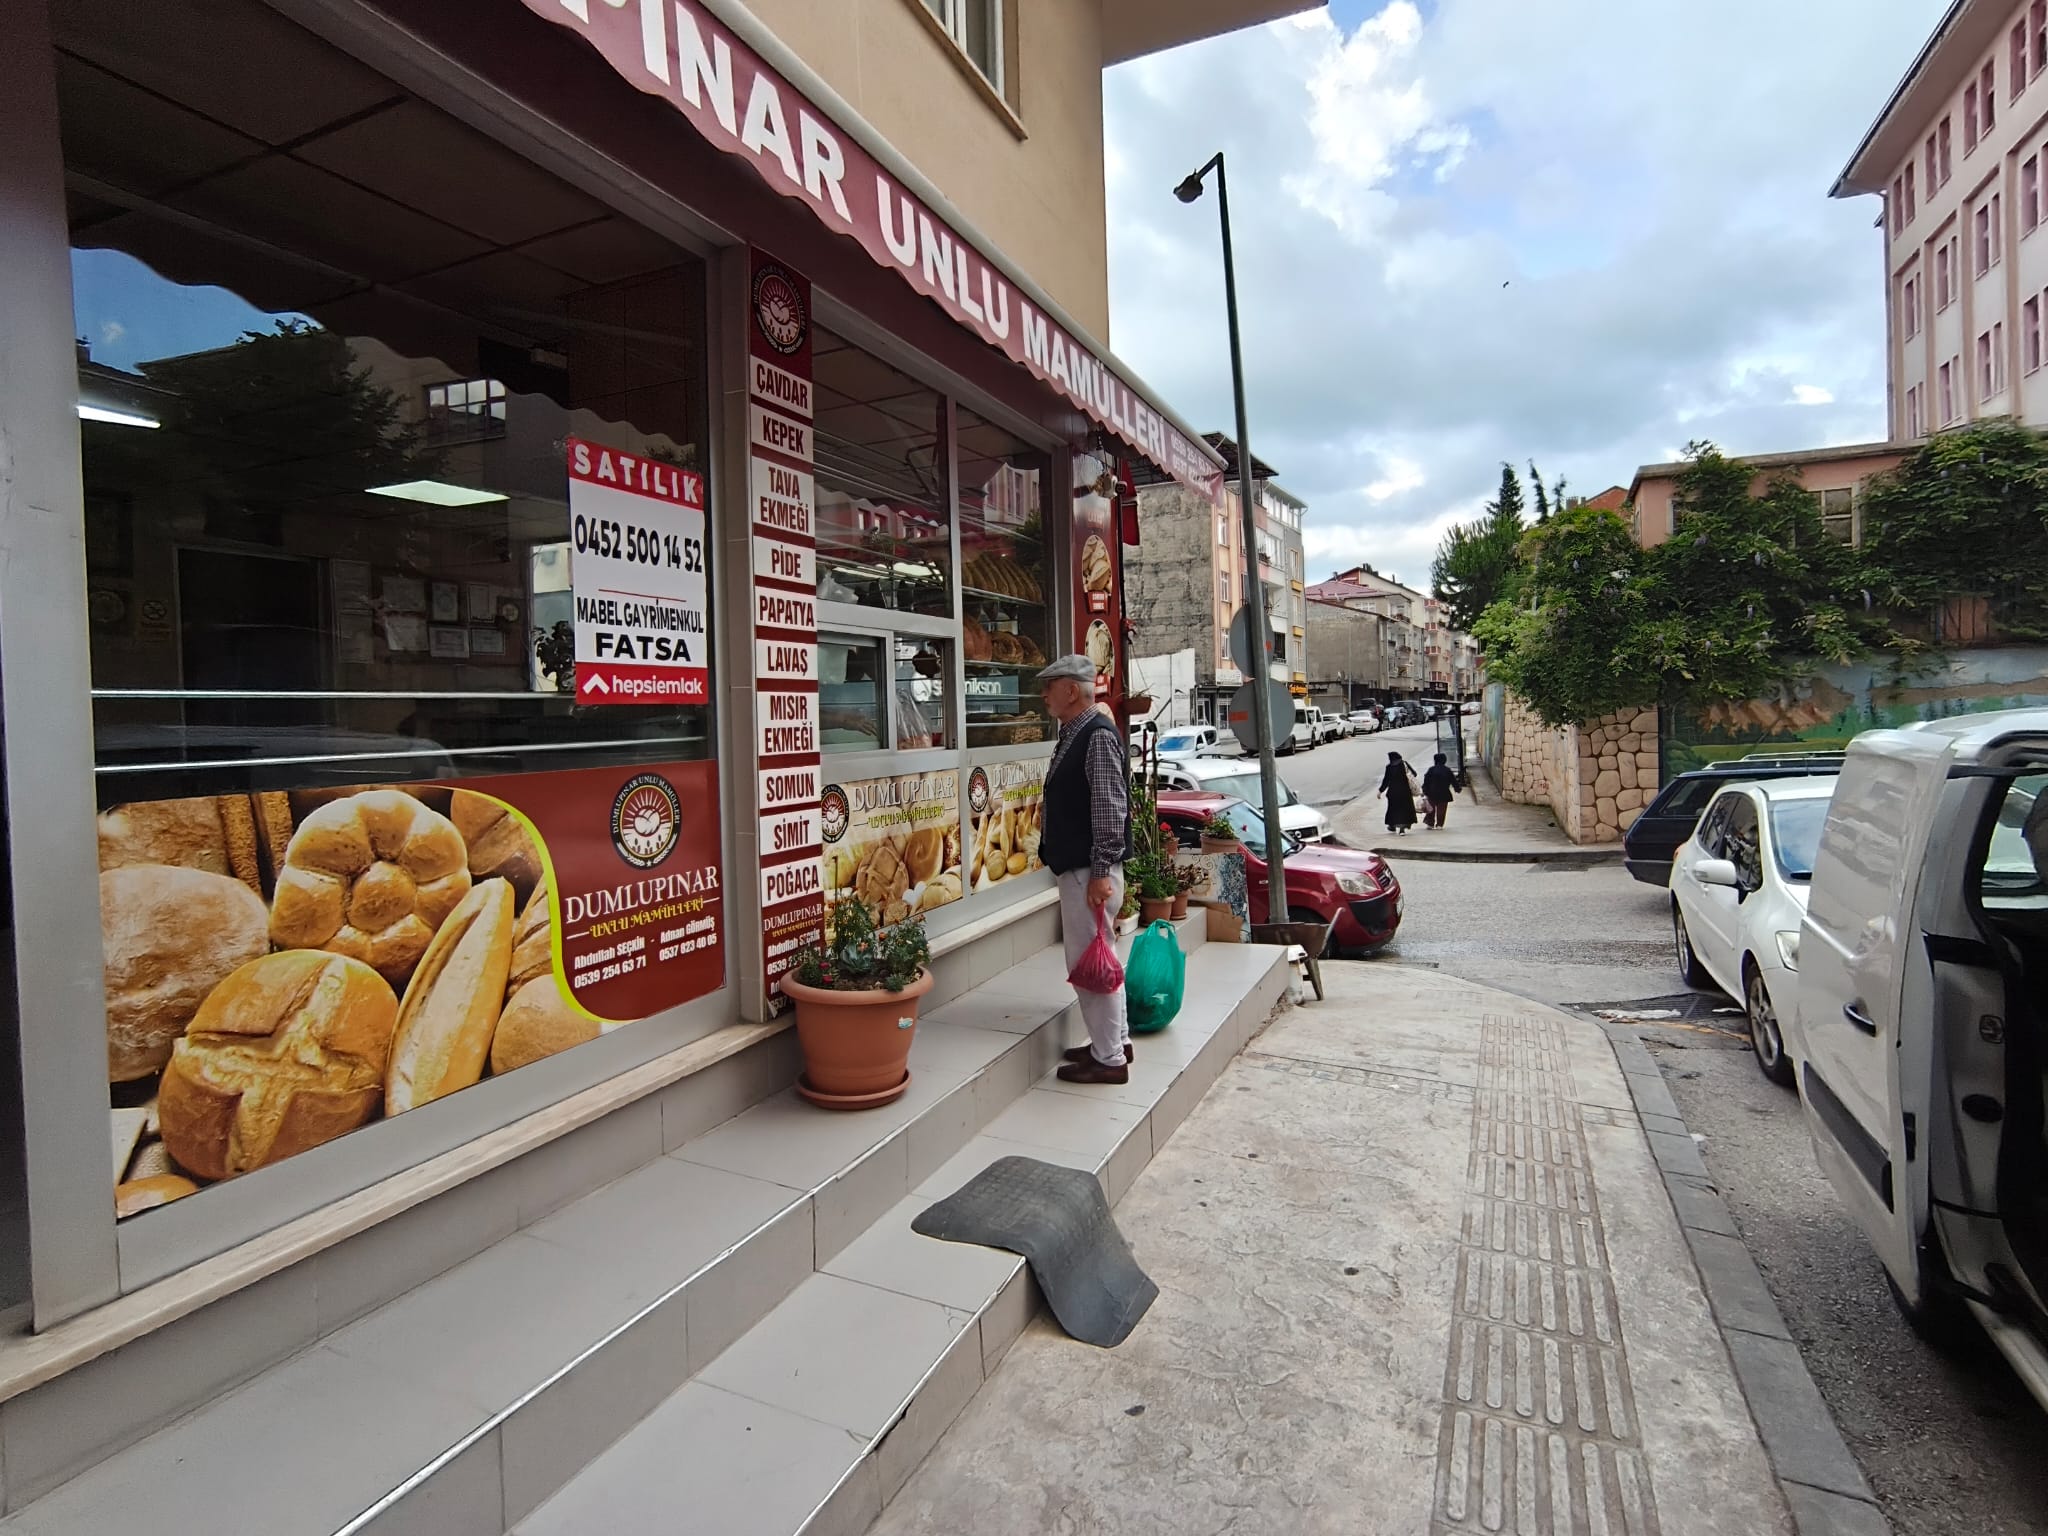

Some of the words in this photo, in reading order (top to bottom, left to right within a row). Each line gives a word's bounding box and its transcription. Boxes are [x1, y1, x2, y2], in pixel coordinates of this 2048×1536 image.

[559, 0, 852, 223] INAR
[876, 174, 1009, 339] UNLU
[1021, 301, 1166, 463] MAMÜLLERİ
[756, 363, 808, 410] ÇAVDAR
[762, 415, 804, 455] KEPEK
[574, 443, 698, 503] SATILIK
[768, 466, 800, 500] TAVA
[760, 496, 809, 533] EKMEĞİ
[574, 514, 622, 560] 0452
[626, 525, 661, 566] 500
[663, 533, 682, 570] 14
[684, 538, 703, 573] 52
[771, 544, 802, 578] PİDE
[577, 597, 622, 627] MABEL
[624, 597, 704, 634] GAYRİMENKUL
[759, 595, 815, 627] PAPATYA
[595, 632, 691, 662] FATSA
[767, 646, 808, 676] LAVAŞ
[612, 674, 703, 697] hepsiemlak
[770, 695, 808, 721] MISIR
[764, 721, 813, 753] EKMEĞİ
[766, 773, 815, 802] SOMUN
[851, 775, 955, 812] DUMLUPINAR
[774, 815, 810, 850] SİMİT
[565, 865, 719, 924] DUMLUPINAR
[766, 864, 819, 901] POĞAÇA
[589, 916, 629, 938] UNLU
[764, 903, 822, 931] DUMLUPINAR
[574, 946, 616, 970] Abdullah
[617, 935, 645, 957] SEÇKİN
[660, 927, 685, 944] Adnan
[659, 944, 679, 961] 0537
[696, 935, 707, 949] 40
[707, 932, 717, 946] 05
[574, 969, 600, 988] 0539
[602, 962, 621, 980] 254
[622, 958, 635, 974] 63
[636, 955, 647, 968] 71
